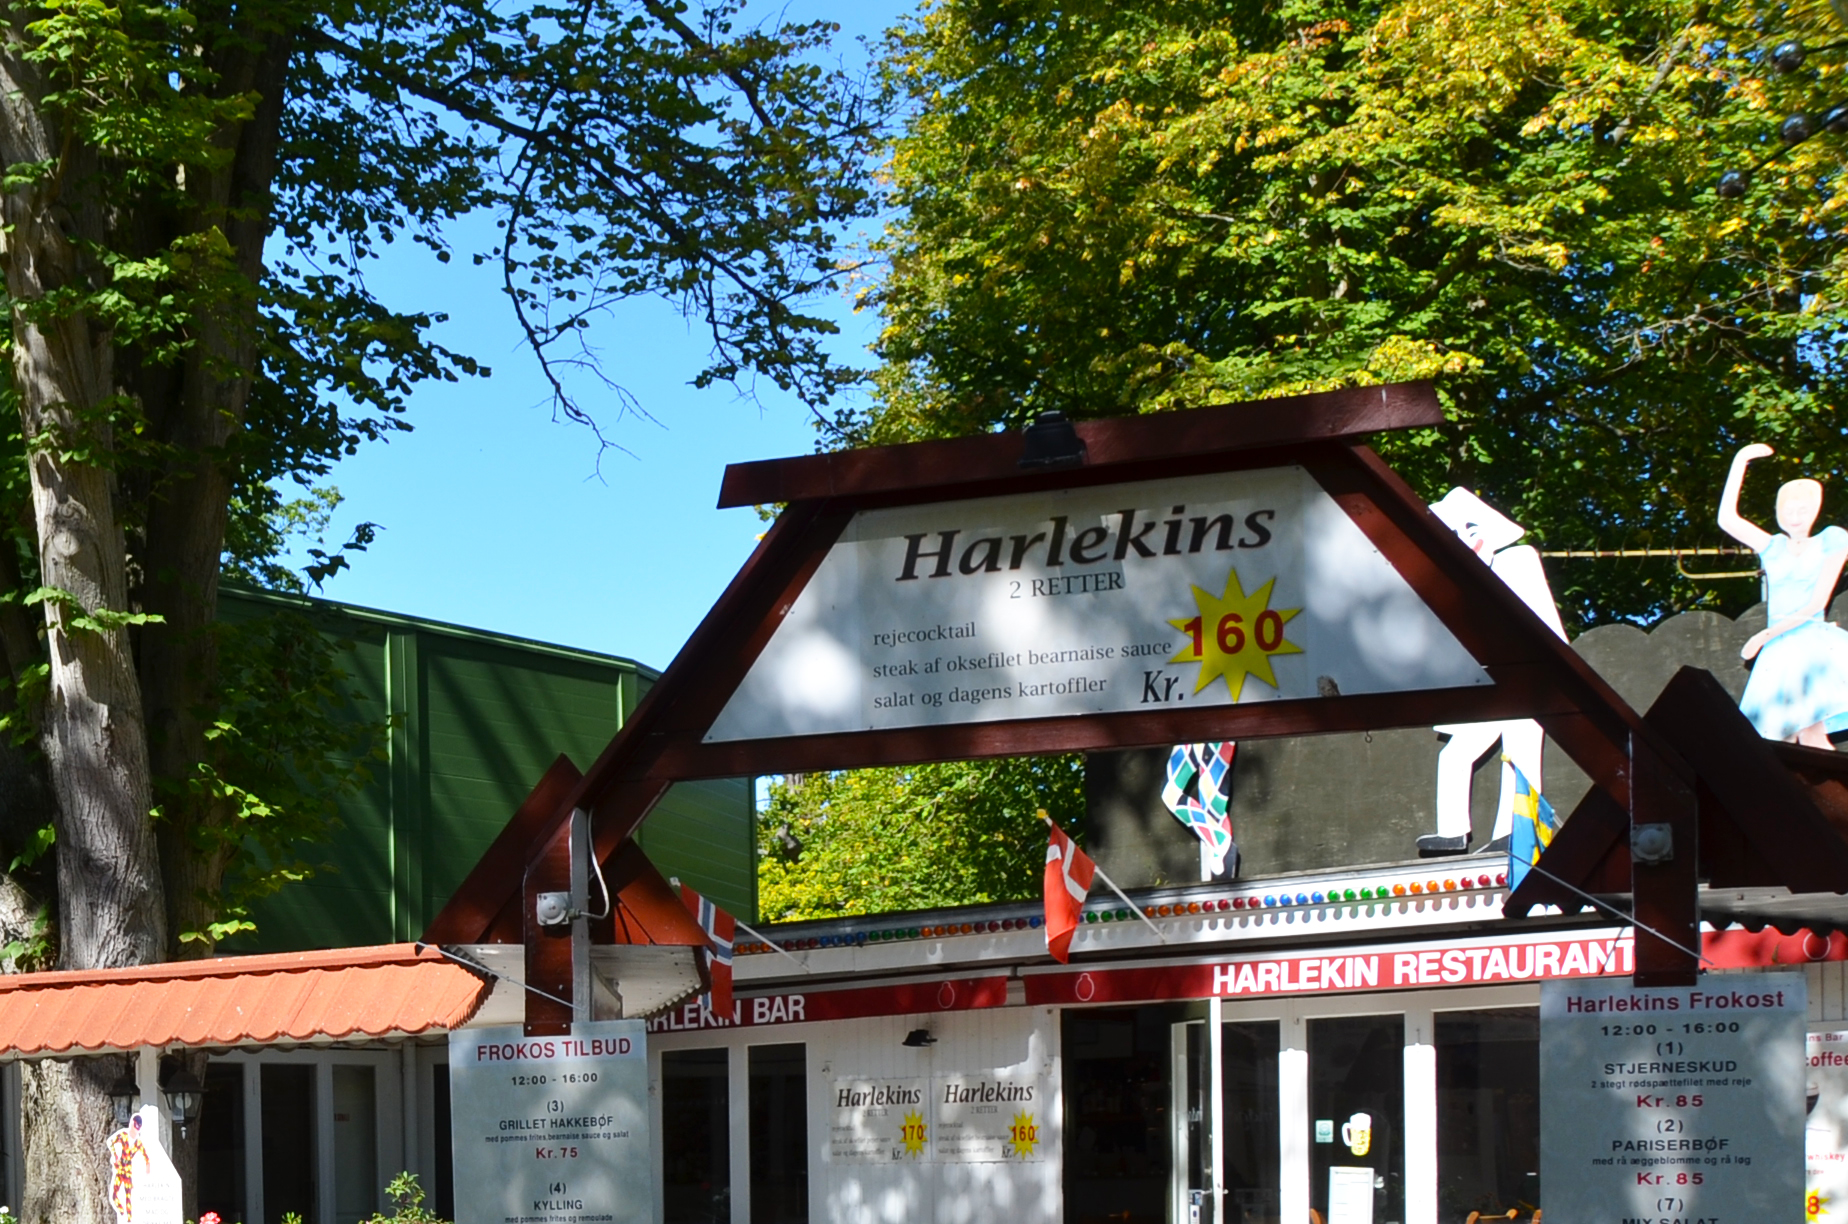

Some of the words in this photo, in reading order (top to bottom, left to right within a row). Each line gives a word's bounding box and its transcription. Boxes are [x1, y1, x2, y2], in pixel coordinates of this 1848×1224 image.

[895, 504, 1276, 582] Harlekins
[1009, 580, 1021, 599] 2
[1031, 571, 1124, 598] RETTER
[873, 622, 976, 648] rejecocktail
[1183, 608, 1284, 657] 160
[873, 659, 920, 679] steak
[924, 657, 942, 674] af
[946, 651, 1023, 673] oksefilet
[1028, 644, 1115, 667] bearnaise
[1120, 639, 1172, 658] sauce
[874, 691, 915, 709] salat
[921, 691, 942, 708] og
[947, 684, 1012, 706] dagens
[1018, 676, 1108, 698] kartoffler
[1140, 669, 1184, 704] Kr.
[1213, 956, 1378, 994] HARLEKIN
[1393, 938, 1635, 986] RESTAURANT
[753, 995, 805, 1024] BAR
[1567, 994, 1679, 1013] Harlekins
[1690, 991, 1784, 1009] Frokost
[1601, 1024, 1656, 1036] 12:00
[1683, 1022, 1740, 1034] 16:00
[477, 1041, 555, 1061] FROKOS
[562, 1038, 631, 1057] TILBUD
[1656, 1042, 1684, 1056] (1)
[1604, 1061, 1737, 1075] STJERNESKUD
[512, 1075, 546, 1086] 12:00
[562, 1073, 598, 1084] 16:00
[1600, 1080, 1626, 1090] stegt
[1628, 1078, 1704, 1090] rødspættefilet
[1706, 1077, 1728, 1086] med
[1731, 1077, 1752, 1087] reje
[837, 1086, 921, 1107] Harlekins
[944, 1082, 1033, 1103] Harlekins
[547, 1100, 564, 1113] (3)
[499, 1119, 546, 1130] GRILLET
[551, 1114, 613, 1129] HAKKEBØF
[1656, 1119, 1684, 1134] (2)
[485, 1135, 499, 1143] med
[500, 1135, 528, 1144] pommes
[602, 1132, 611, 1140] og
[613, 1130, 629, 1138] salat
[902, 1125, 924, 1140] 170
[1012, 1126, 1035, 1141] 160
[1612, 1137, 1729, 1153] PARISERBØF
[1592, 1157, 1613, 1165] med
[1617, 1154, 1627, 1165] rå
[1630, 1155, 1700, 1167] æggeblomme
[1704, 1157, 1717, 1167] og
[1721, 1154, 1731, 1165] rå
[1734, 1155, 1751, 1166] løg
[549, 1182, 567, 1195] (4)
[534, 1200, 583, 1211] KYLLING
[1656, 1198, 1684, 1213] (7)
[505, 1216, 518, 1224] med
[520, 1215, 548, 1224] pommes
[549, 1214, 567, 1223] frites
[568, 1215, 577, 1224] og
[578, 1213, 613, 1222] remoulade
